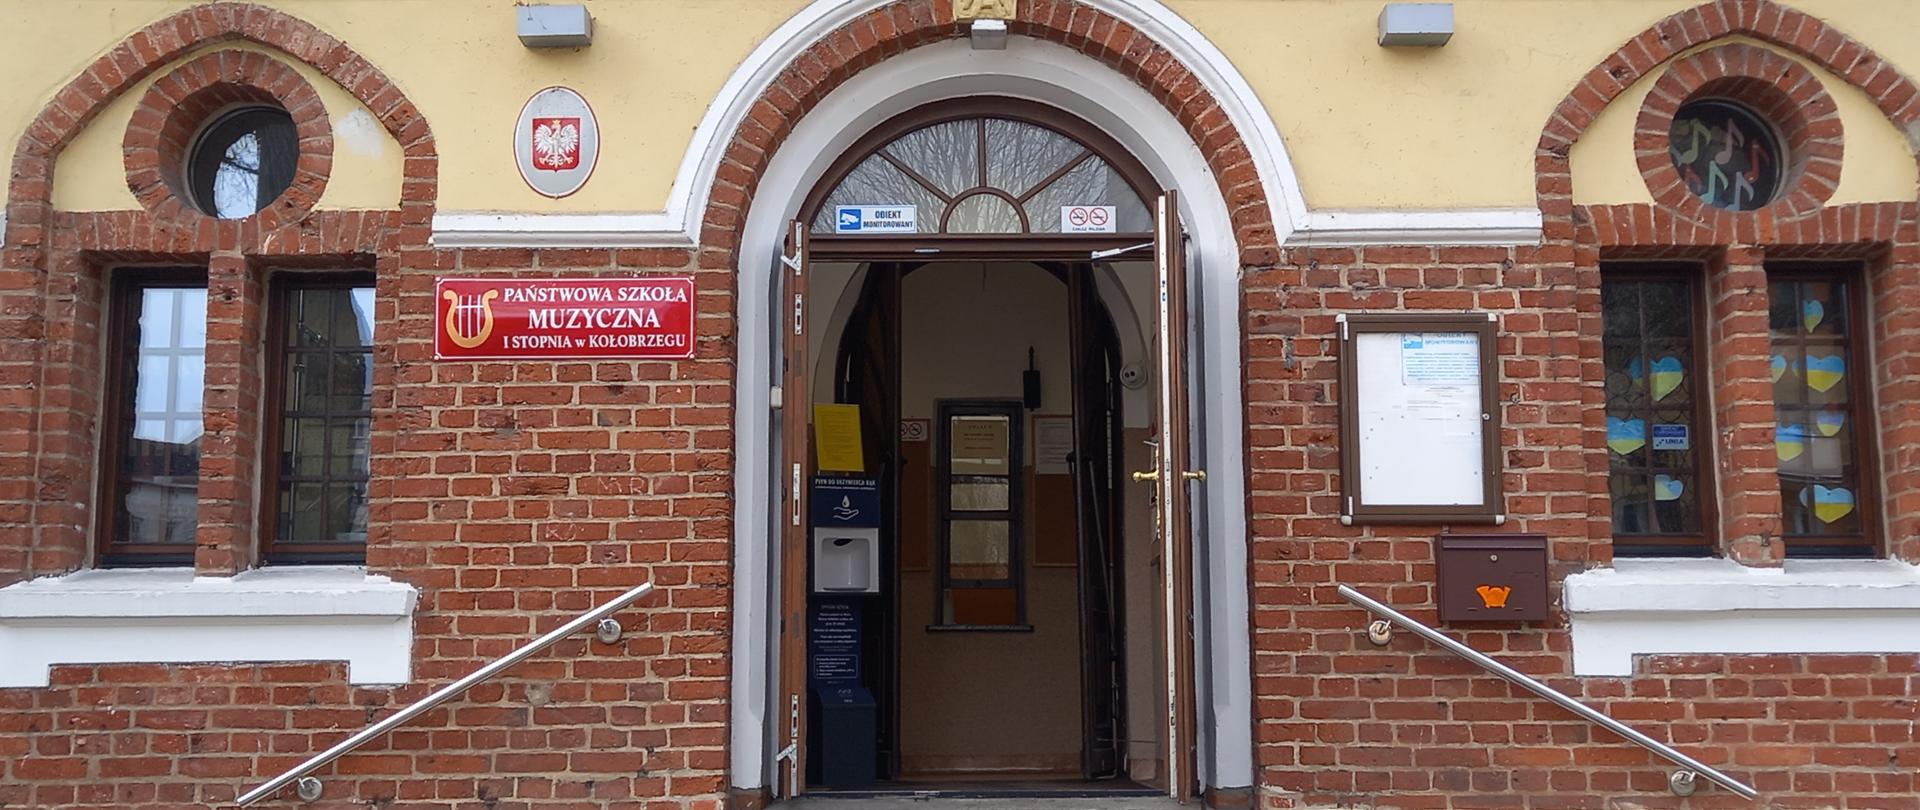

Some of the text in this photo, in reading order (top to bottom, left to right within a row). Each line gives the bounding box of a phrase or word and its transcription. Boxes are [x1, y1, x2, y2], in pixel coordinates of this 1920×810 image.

[503, 284, 688, 303] PAŃSTWOWA SZKOŁA
[527, 307, 661, 330] MUZYCZNA
[503, 334, 686, 349] I STOPNIA w KOŁOBRZEGU
